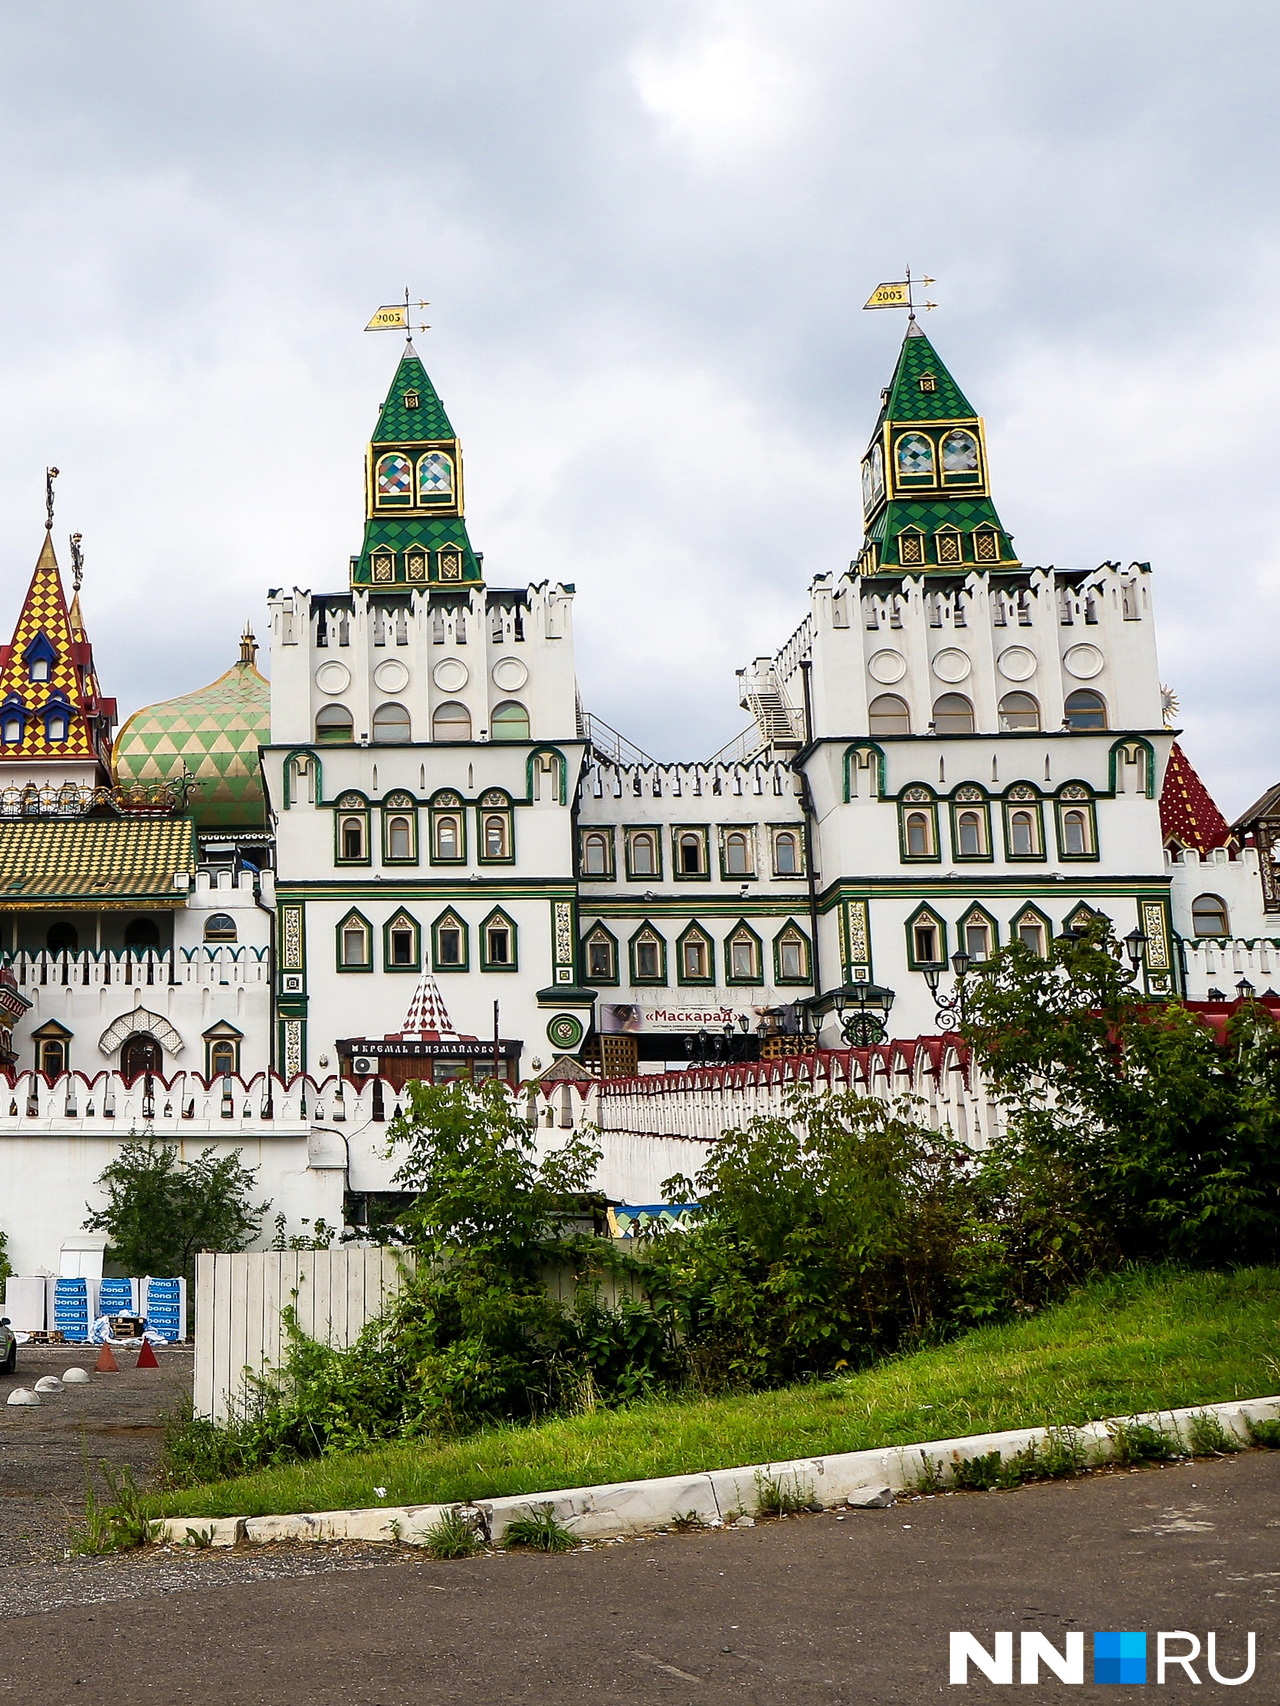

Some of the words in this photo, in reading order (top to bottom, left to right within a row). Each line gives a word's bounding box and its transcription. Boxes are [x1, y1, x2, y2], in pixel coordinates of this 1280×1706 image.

[875, 290, 902, 301] 2003
[645, 1007, 741, 1024] «Маскарад»
[361, 1044, 409, 1054] КРЕМЛЬ
[413, 1045, 421, 1054] В
[424, 1044, 495, 1054] ИЗМАЙЛОВО
